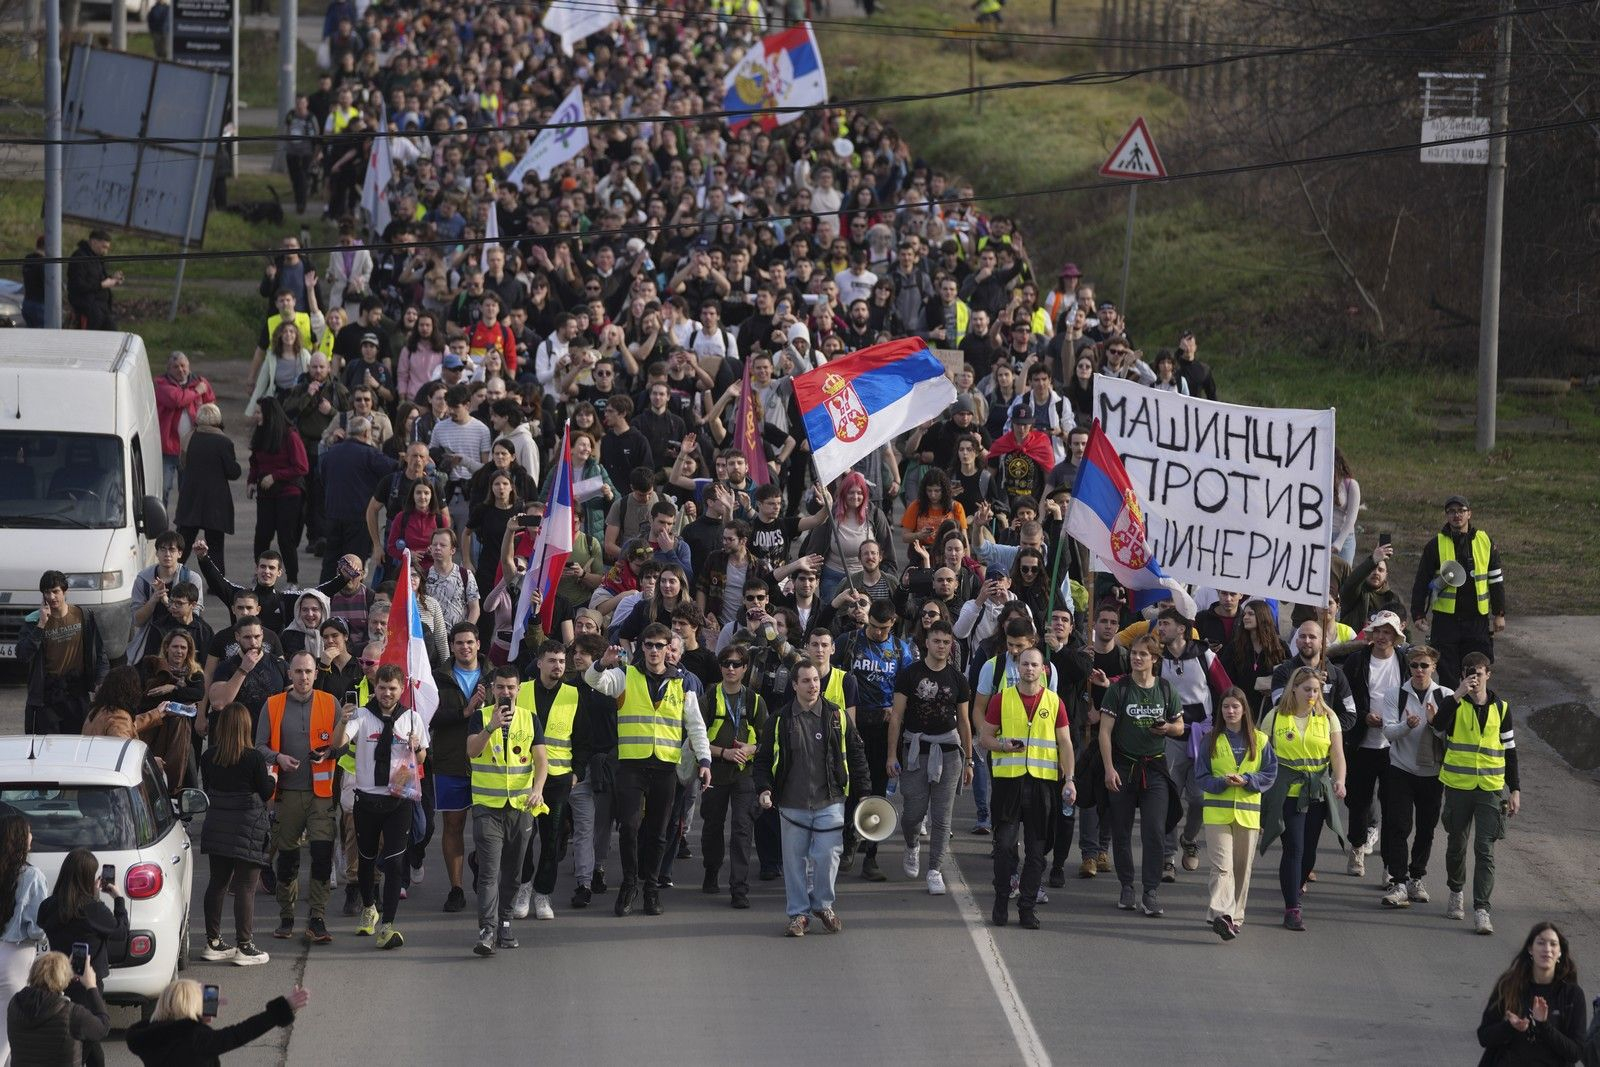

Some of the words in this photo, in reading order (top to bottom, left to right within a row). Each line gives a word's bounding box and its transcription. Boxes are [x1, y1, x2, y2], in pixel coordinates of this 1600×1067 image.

[1100, 392, 1317, 471] МАШИНЦИ
[1120, 453, 1324, 530] ПРОТИВ
[752, 529, 785, 547] JONES
[1144, 513, 1326, 596] ШИНЕРИЈЕ
[853, 659, 896, 674] ARILJE
[1125, 703, 1165, 719] Carlsberg
